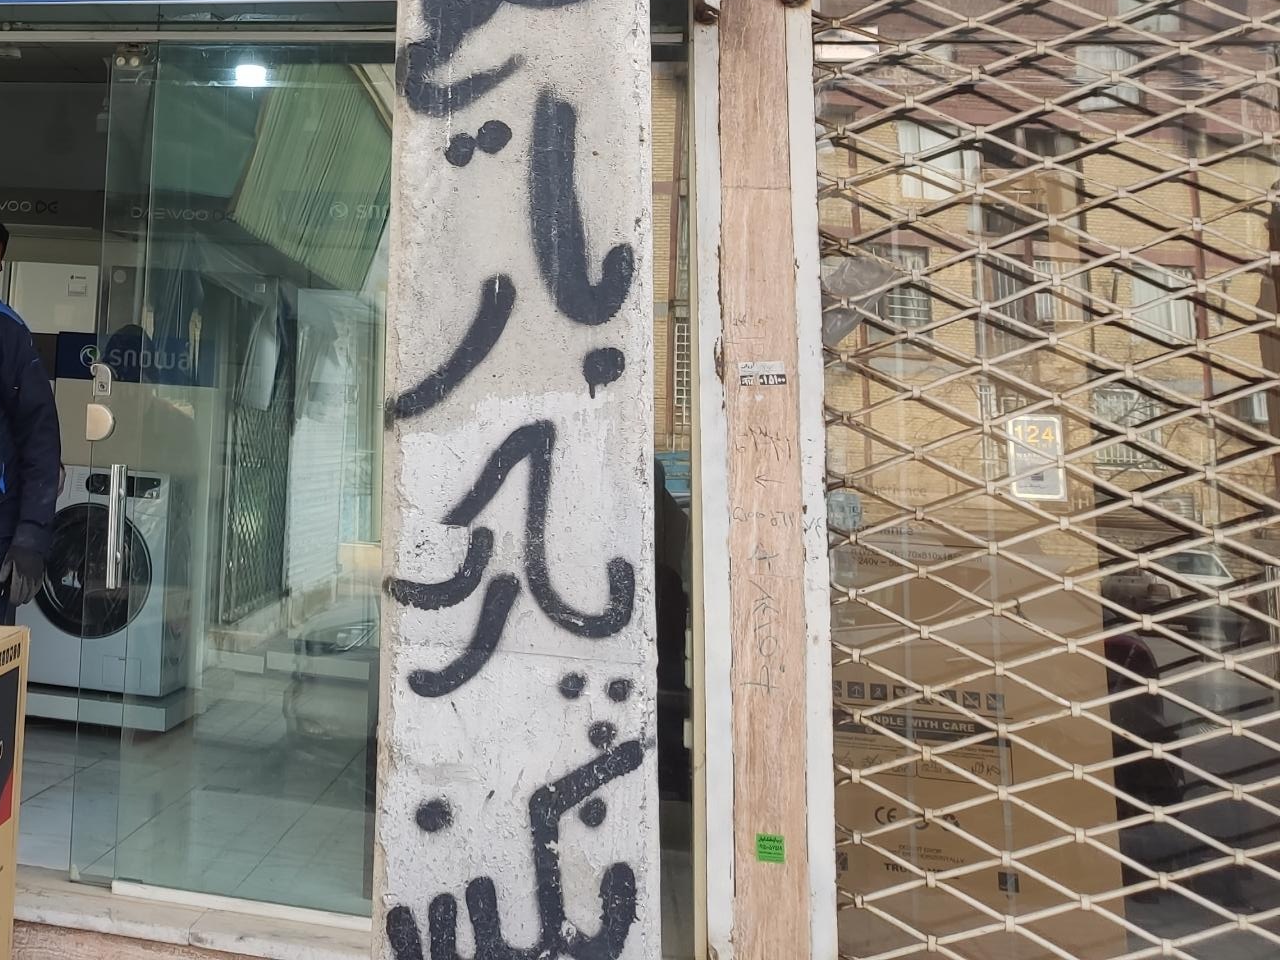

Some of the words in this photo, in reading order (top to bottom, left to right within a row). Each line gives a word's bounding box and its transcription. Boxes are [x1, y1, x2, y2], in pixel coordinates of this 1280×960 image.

[109, 347, 192, 371] snowa
[1014, 424, 1055, 443] 124
[869, 714, 905, 727] NDLE
[942, 721, 975, 733] CARE
